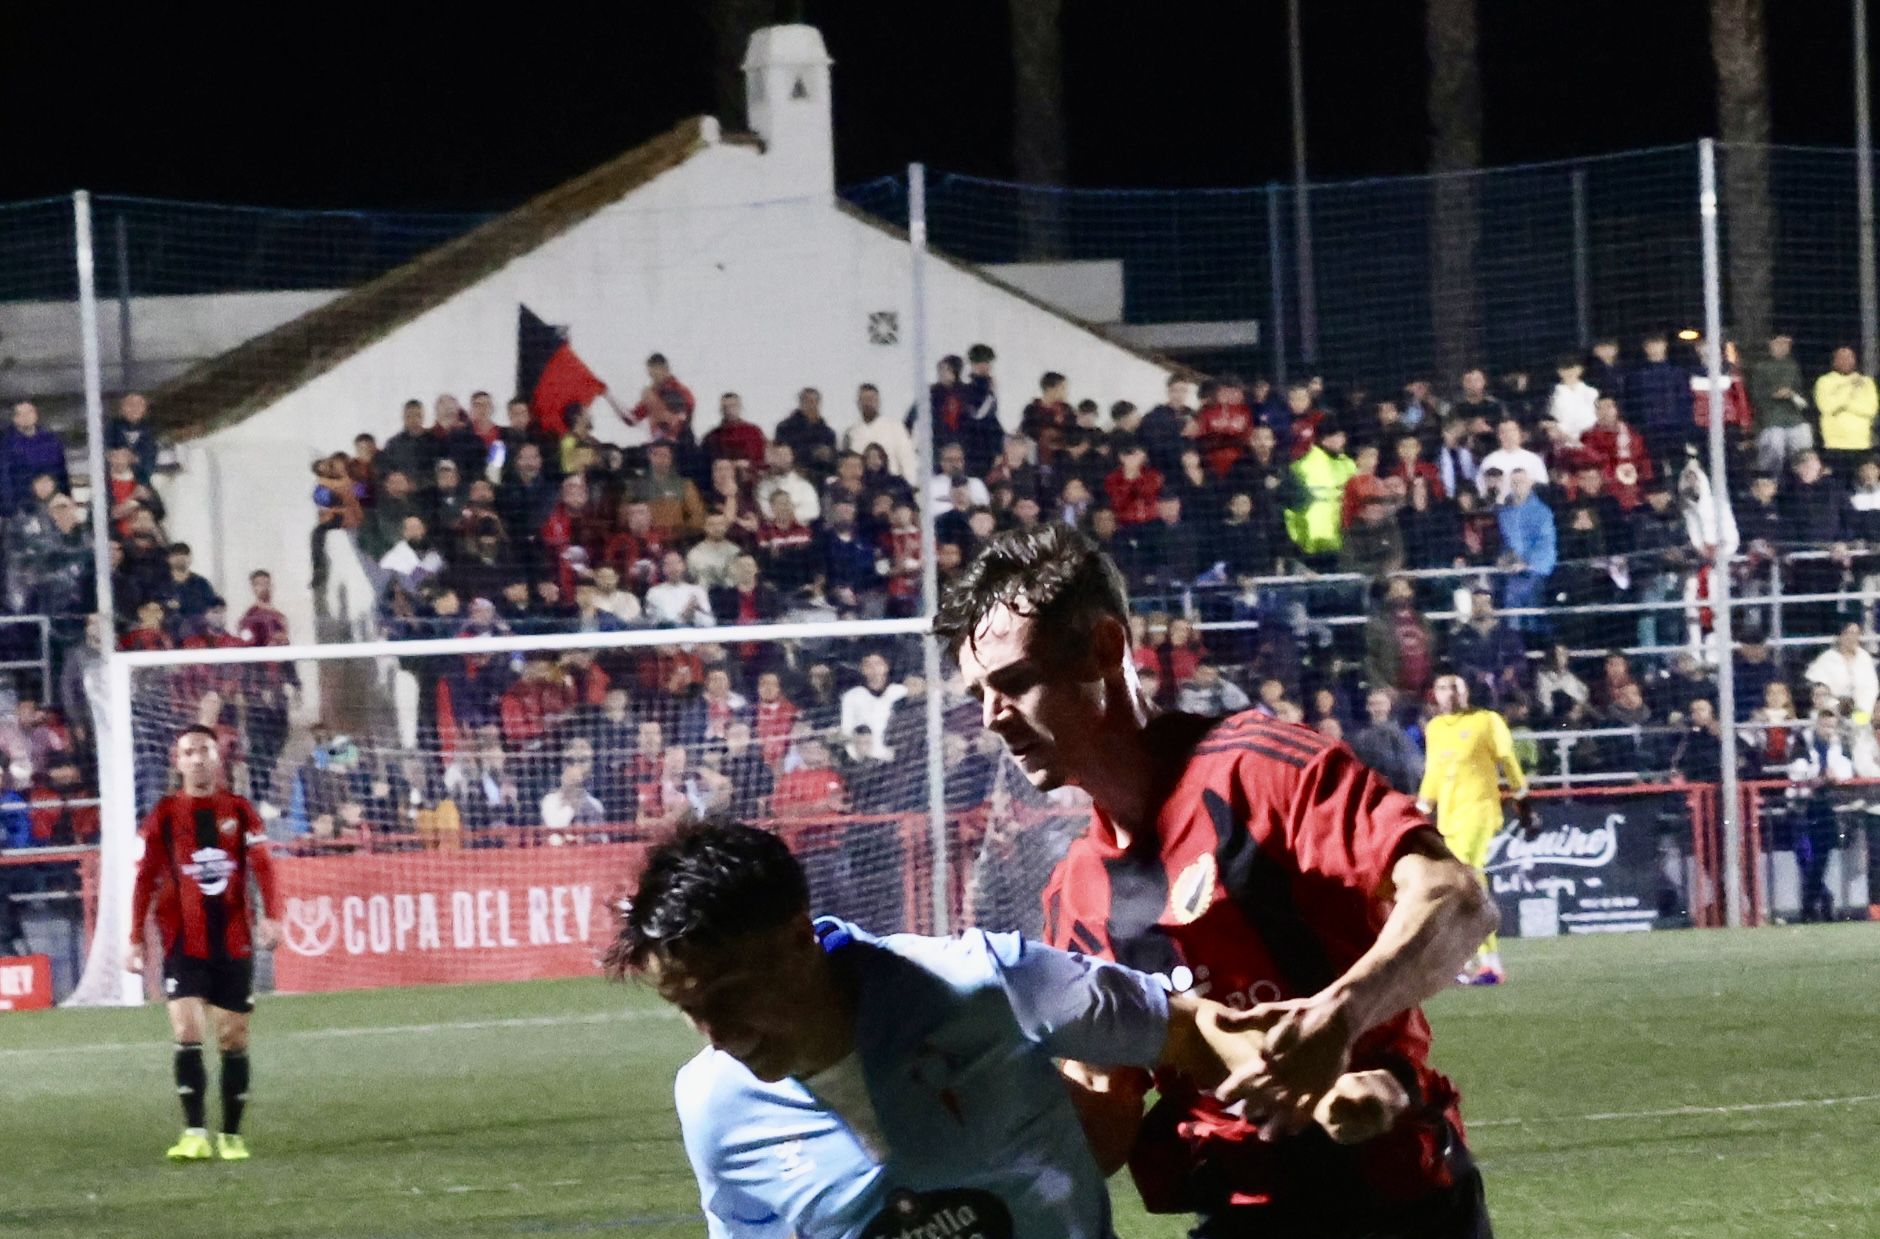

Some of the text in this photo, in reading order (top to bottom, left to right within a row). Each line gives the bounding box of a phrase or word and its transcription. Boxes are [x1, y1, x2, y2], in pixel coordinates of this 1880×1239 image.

[343, 885, 592, 954] COPA DEL REY
